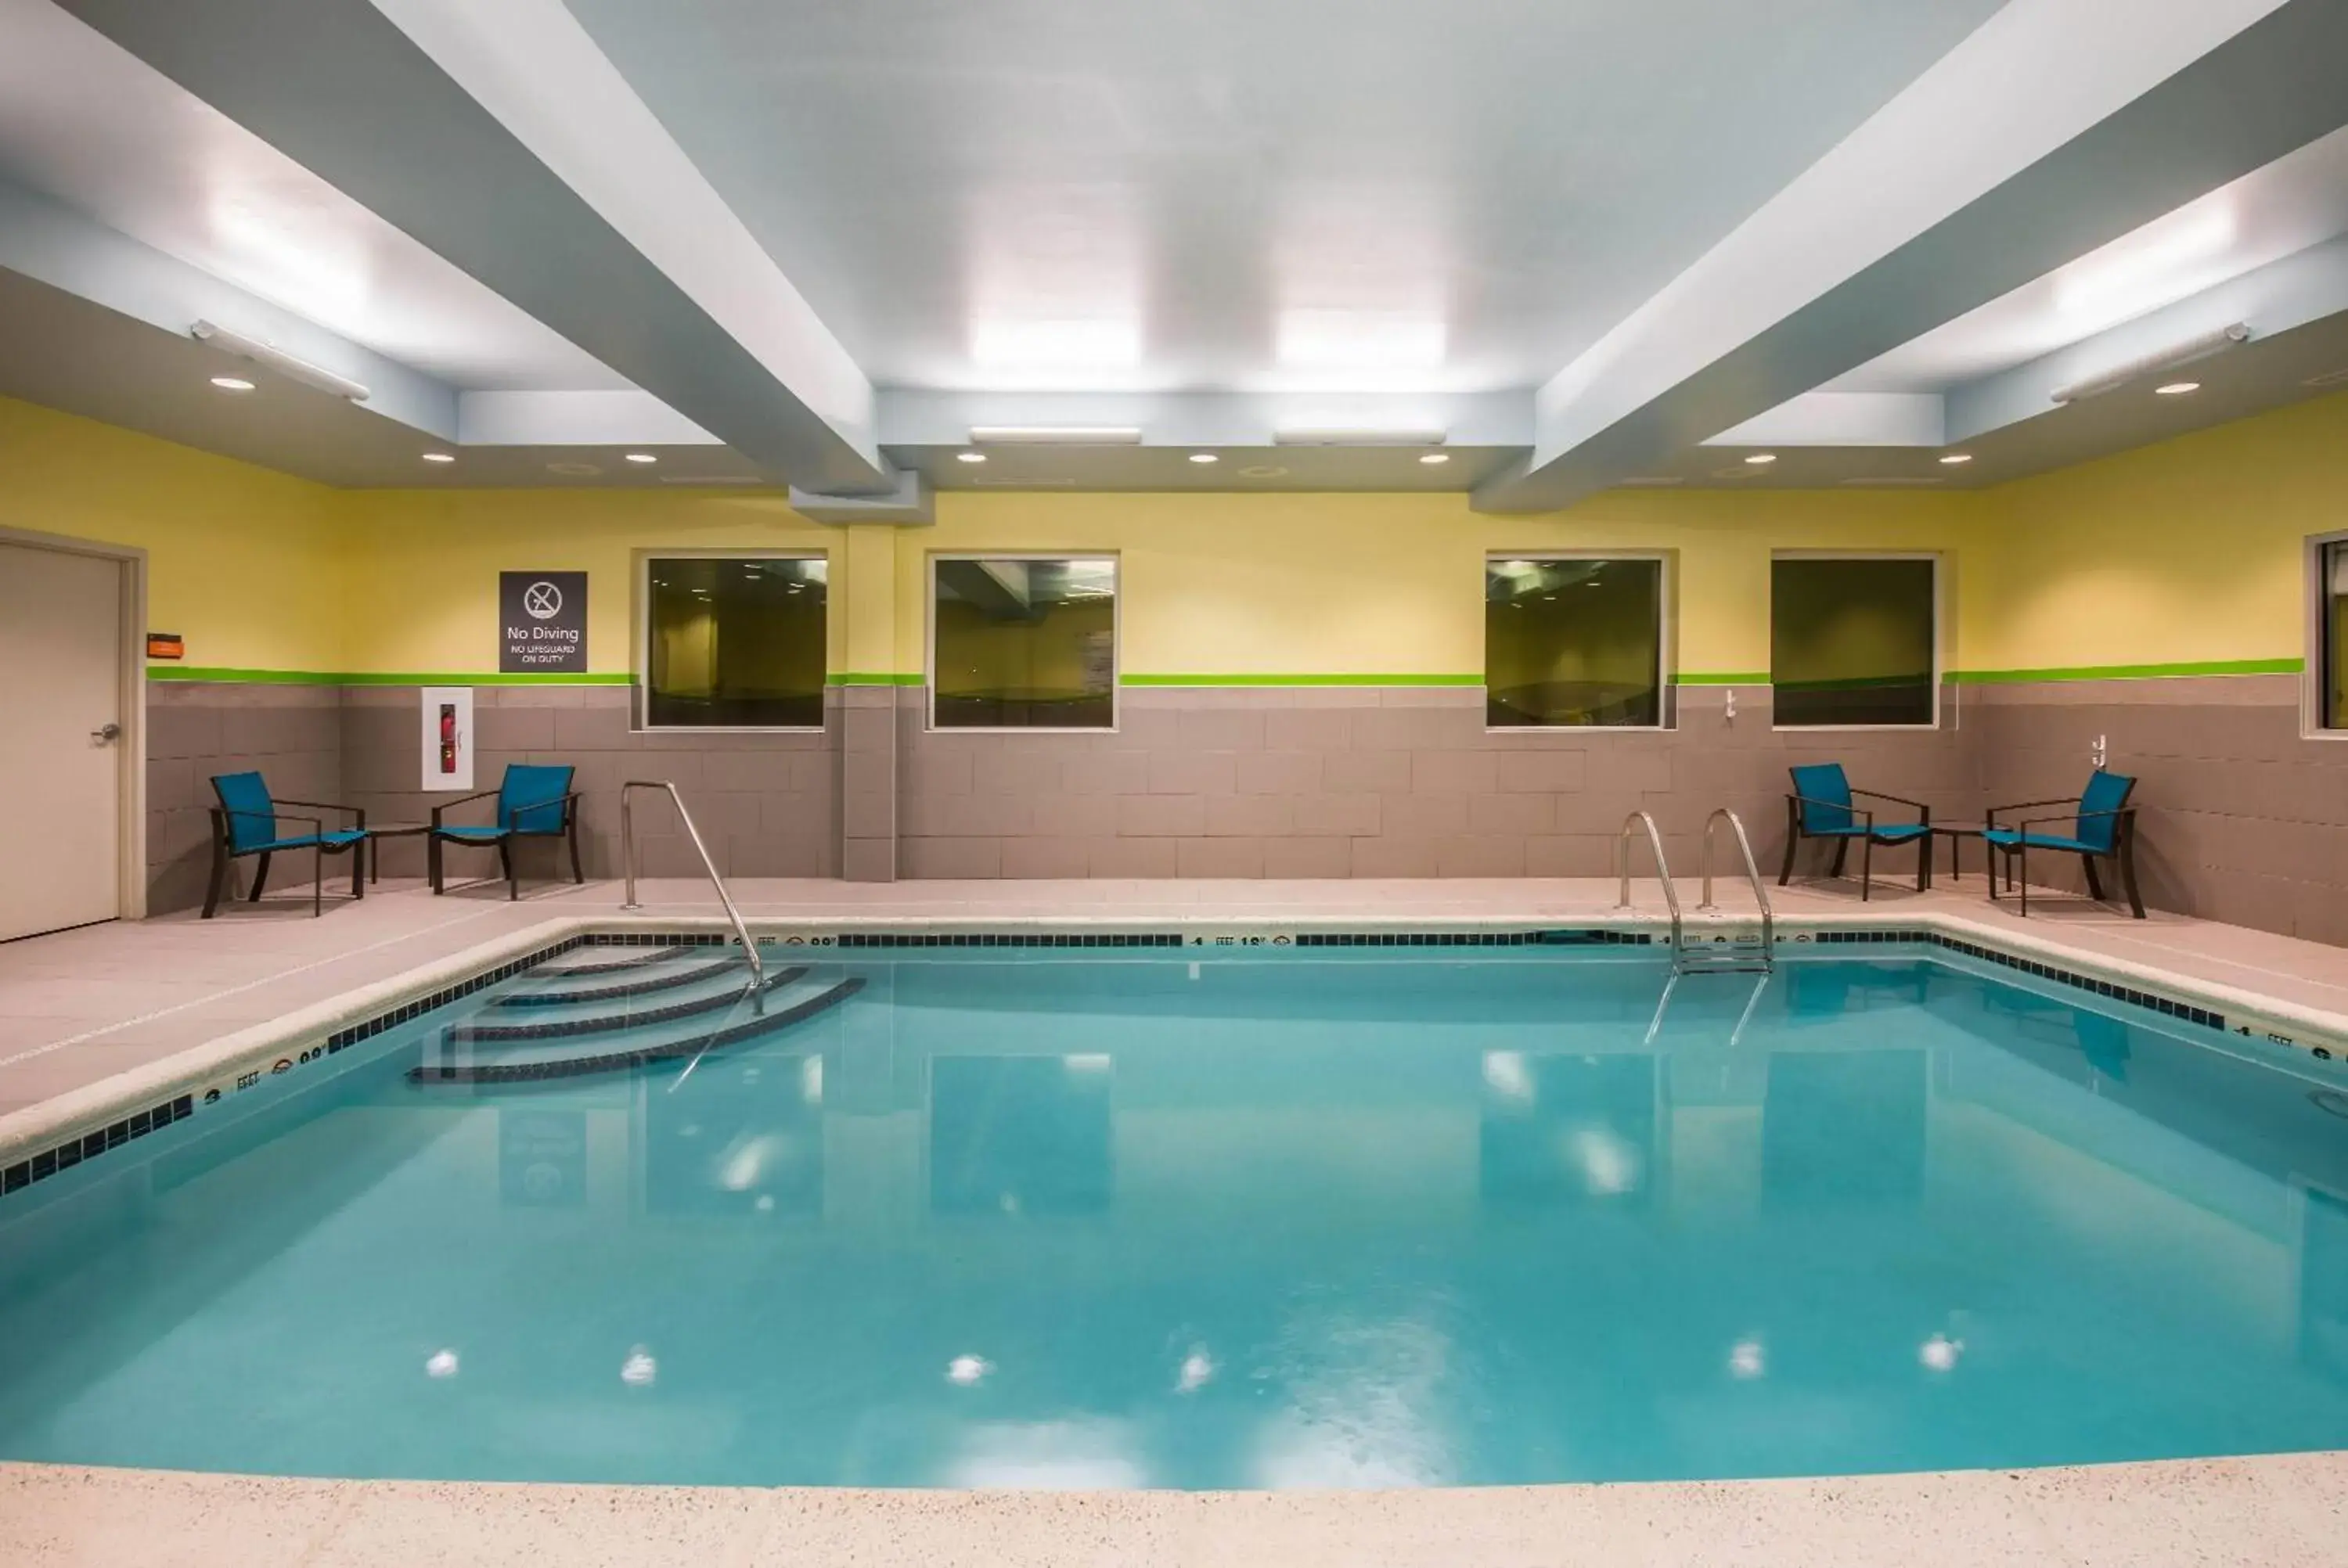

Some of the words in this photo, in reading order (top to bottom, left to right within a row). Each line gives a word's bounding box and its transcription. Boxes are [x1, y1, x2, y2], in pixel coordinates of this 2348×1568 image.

[508, 627, 528, 639] No
[533, 627, 578, 643] Diving
[511, 645, 525, 653] NO
[527, 645, 575, 653] LIFEGUARD
